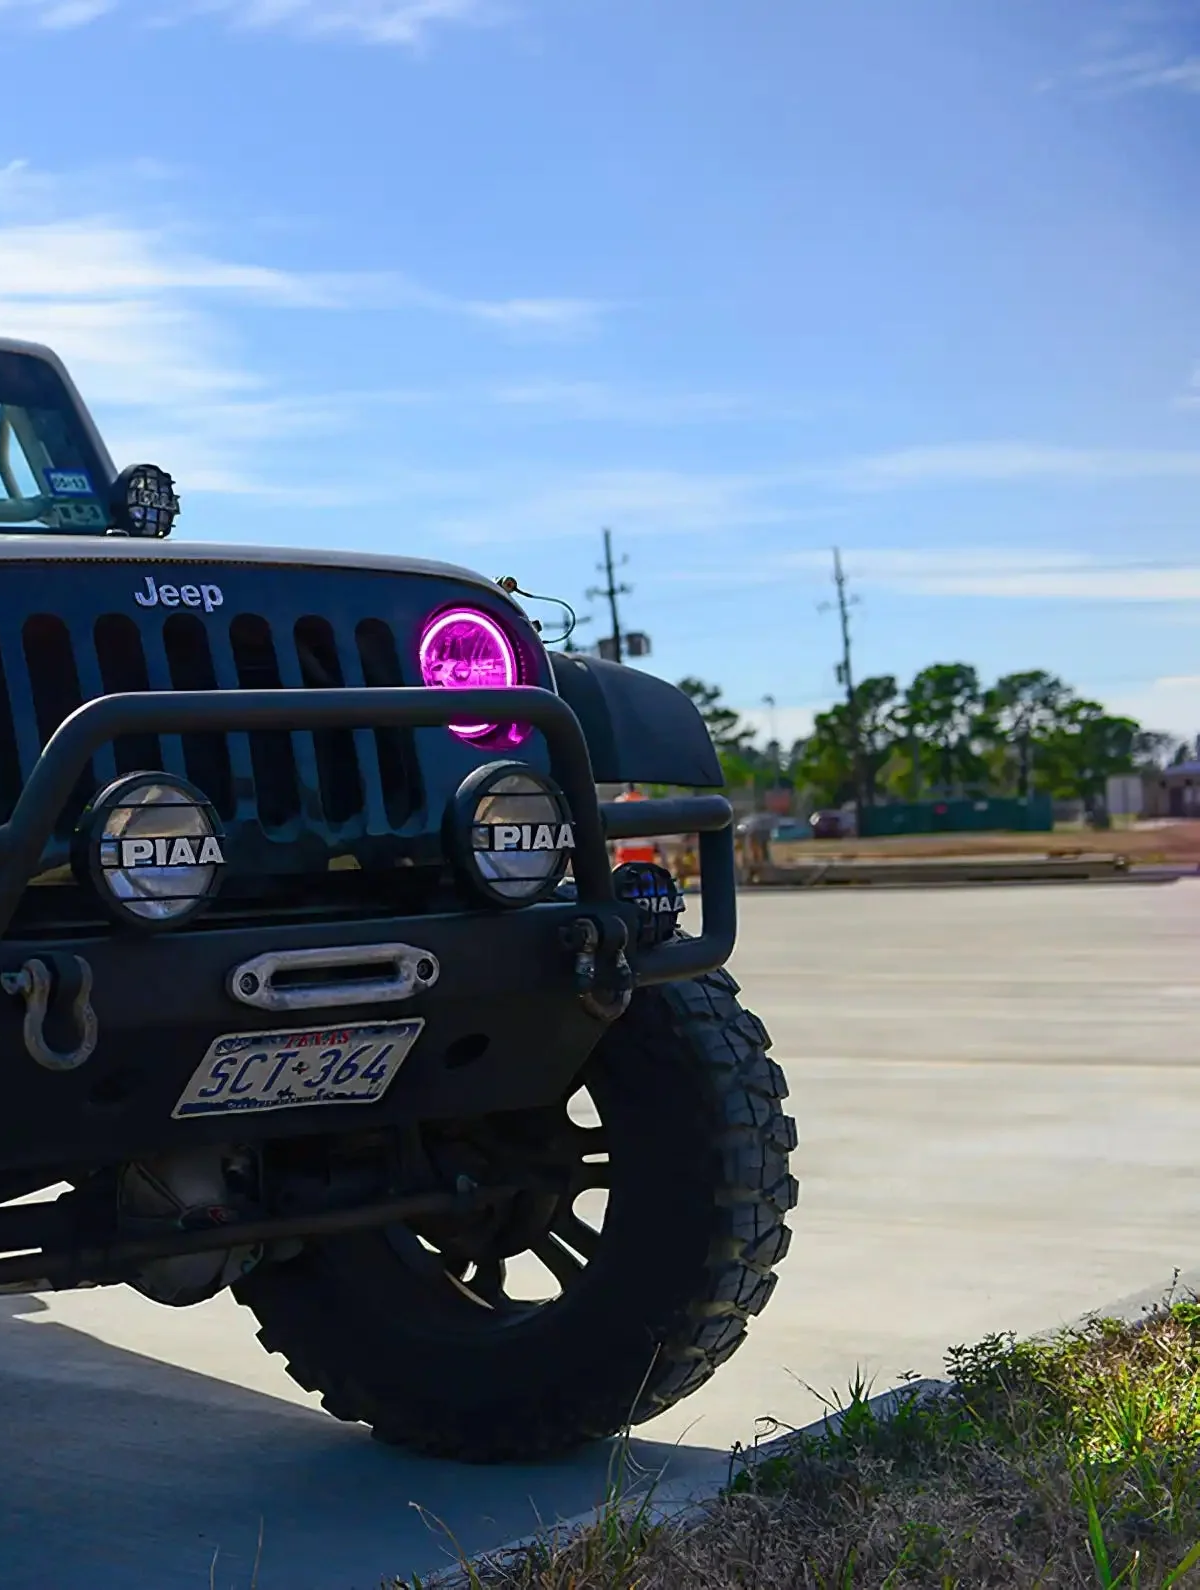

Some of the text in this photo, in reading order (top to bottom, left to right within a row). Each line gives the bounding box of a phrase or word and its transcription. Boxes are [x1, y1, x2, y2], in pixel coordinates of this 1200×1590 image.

[134, 576, 224, 613] Jeep
[121, 836, 225, 868] PIAA
[493, 823, 576, 852] PIAA
[284, 1029, 354, 1050] TEXAS
[197, 1043, 396, 1098] SCT 364
